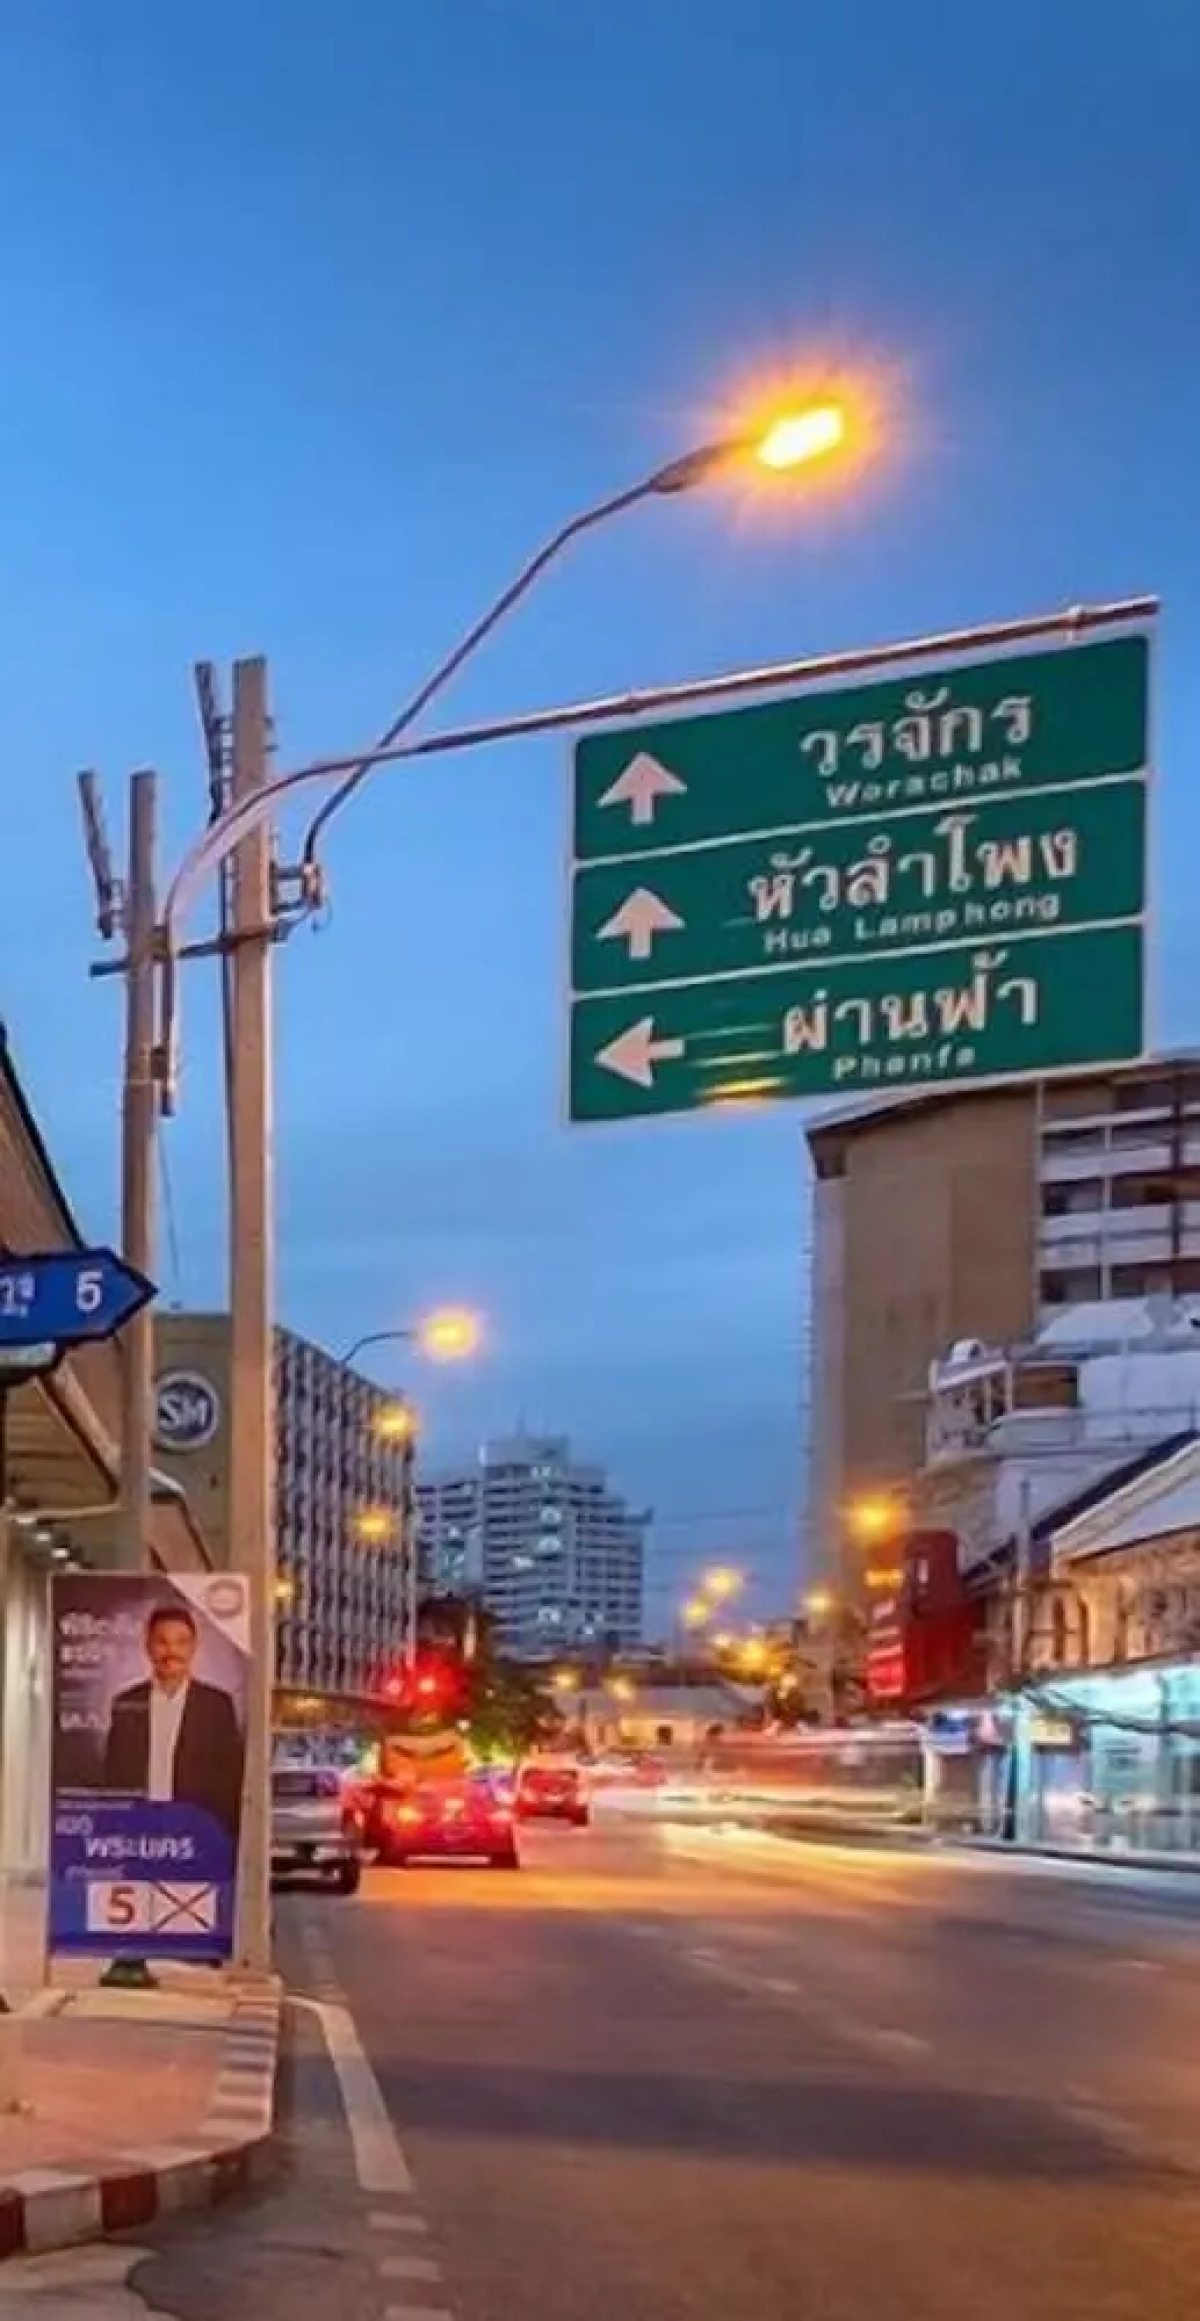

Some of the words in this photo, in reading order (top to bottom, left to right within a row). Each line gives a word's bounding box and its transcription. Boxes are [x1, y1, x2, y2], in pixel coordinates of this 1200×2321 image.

[800, 686, 1032, 777] วรจักร
[826, 755, 1022, 808] Worachak
[748, 814, 1077, 921] หัวลำโพง
[764, 927, 832, 952] Hua
[854, 894, 1060, 940] Lamphong
[783, 949, 1037, 1054] ผ่านฟ้า
[833, 1043, 976, 1080] Phanfa
[77, 1270, 103, 1312] 5
[108, 1886, 136, 1925] 5
